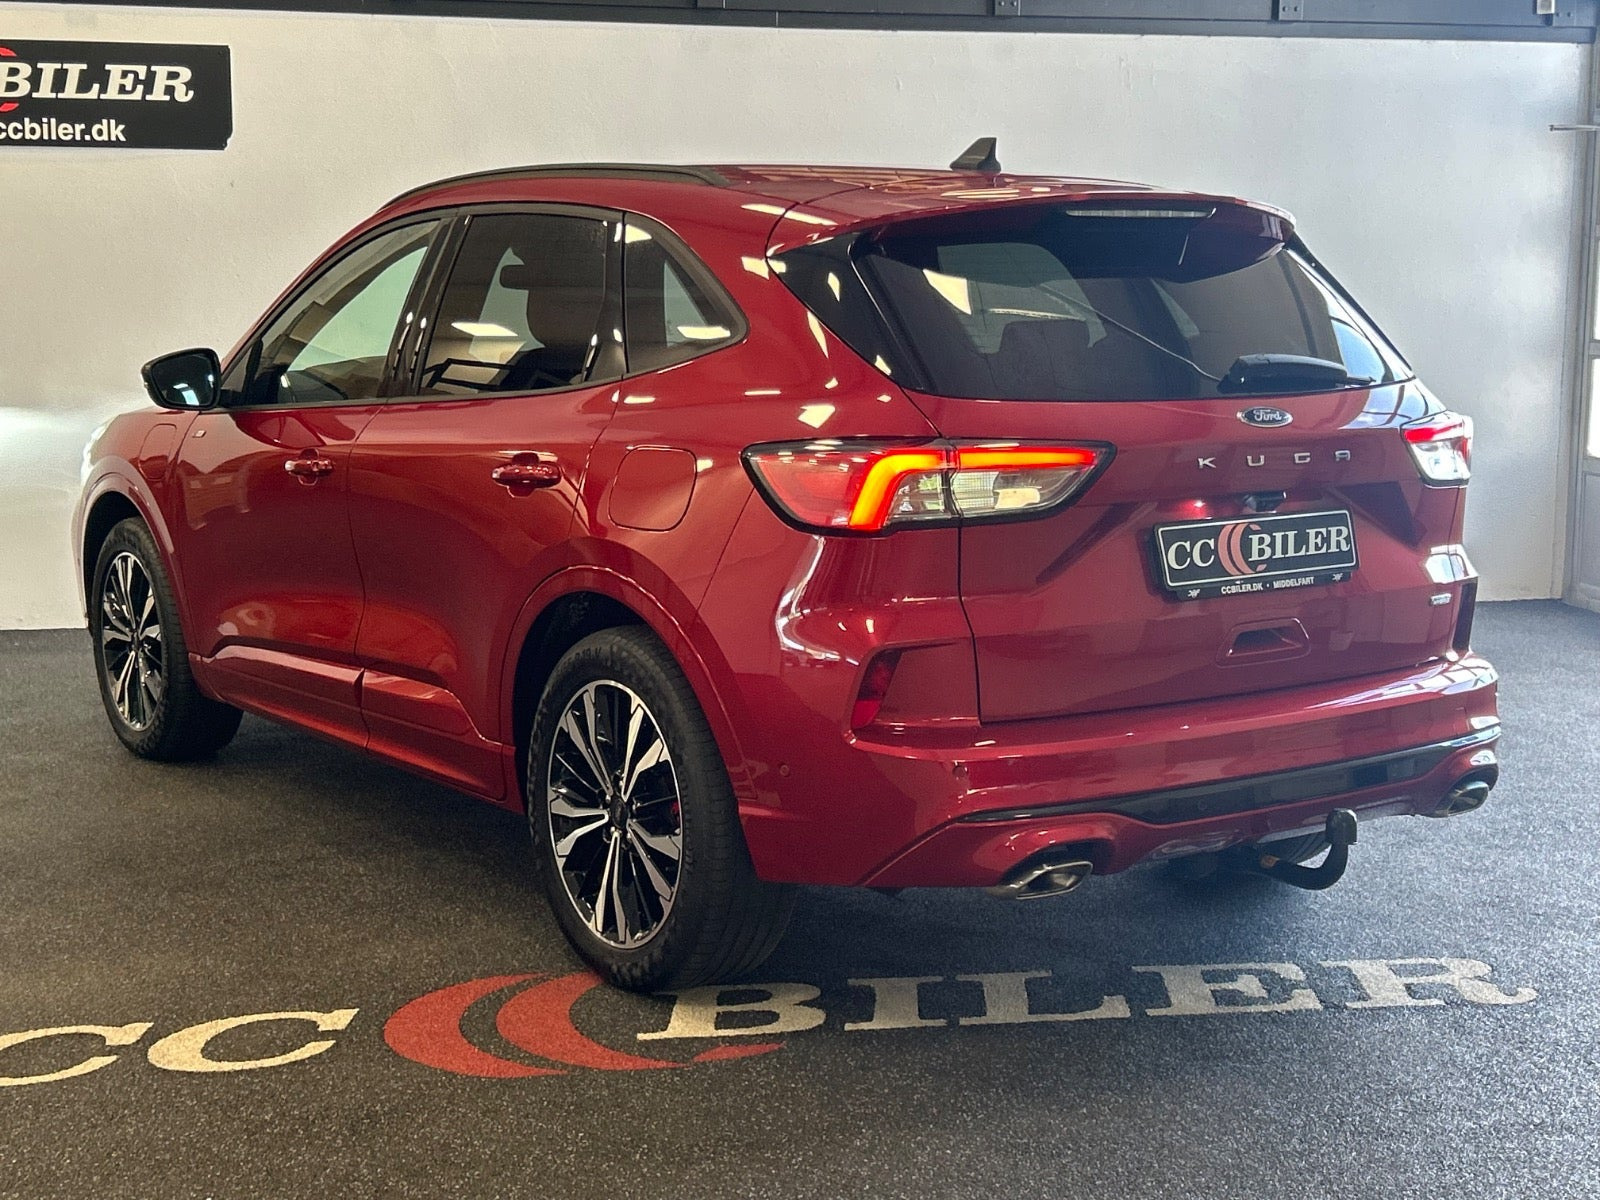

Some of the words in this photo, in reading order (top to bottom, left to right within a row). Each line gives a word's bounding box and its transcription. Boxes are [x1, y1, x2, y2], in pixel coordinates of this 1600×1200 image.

[0, 61, 194, 103] BILER
[1253, 409, 1282, 421] Ford
[1198, 450, 1350, 469] KUGA
[1167, 538, 1215, 570] CC
[1248, 525, 1351, 562] BILER
[1221, 582, 1264, 595] CCBILER.DK
[1273, 576, 1315, 589] MIDDELFART
[0, 1008, 360, 1086] CC
[636, 957, 1538, 1041] BILER
